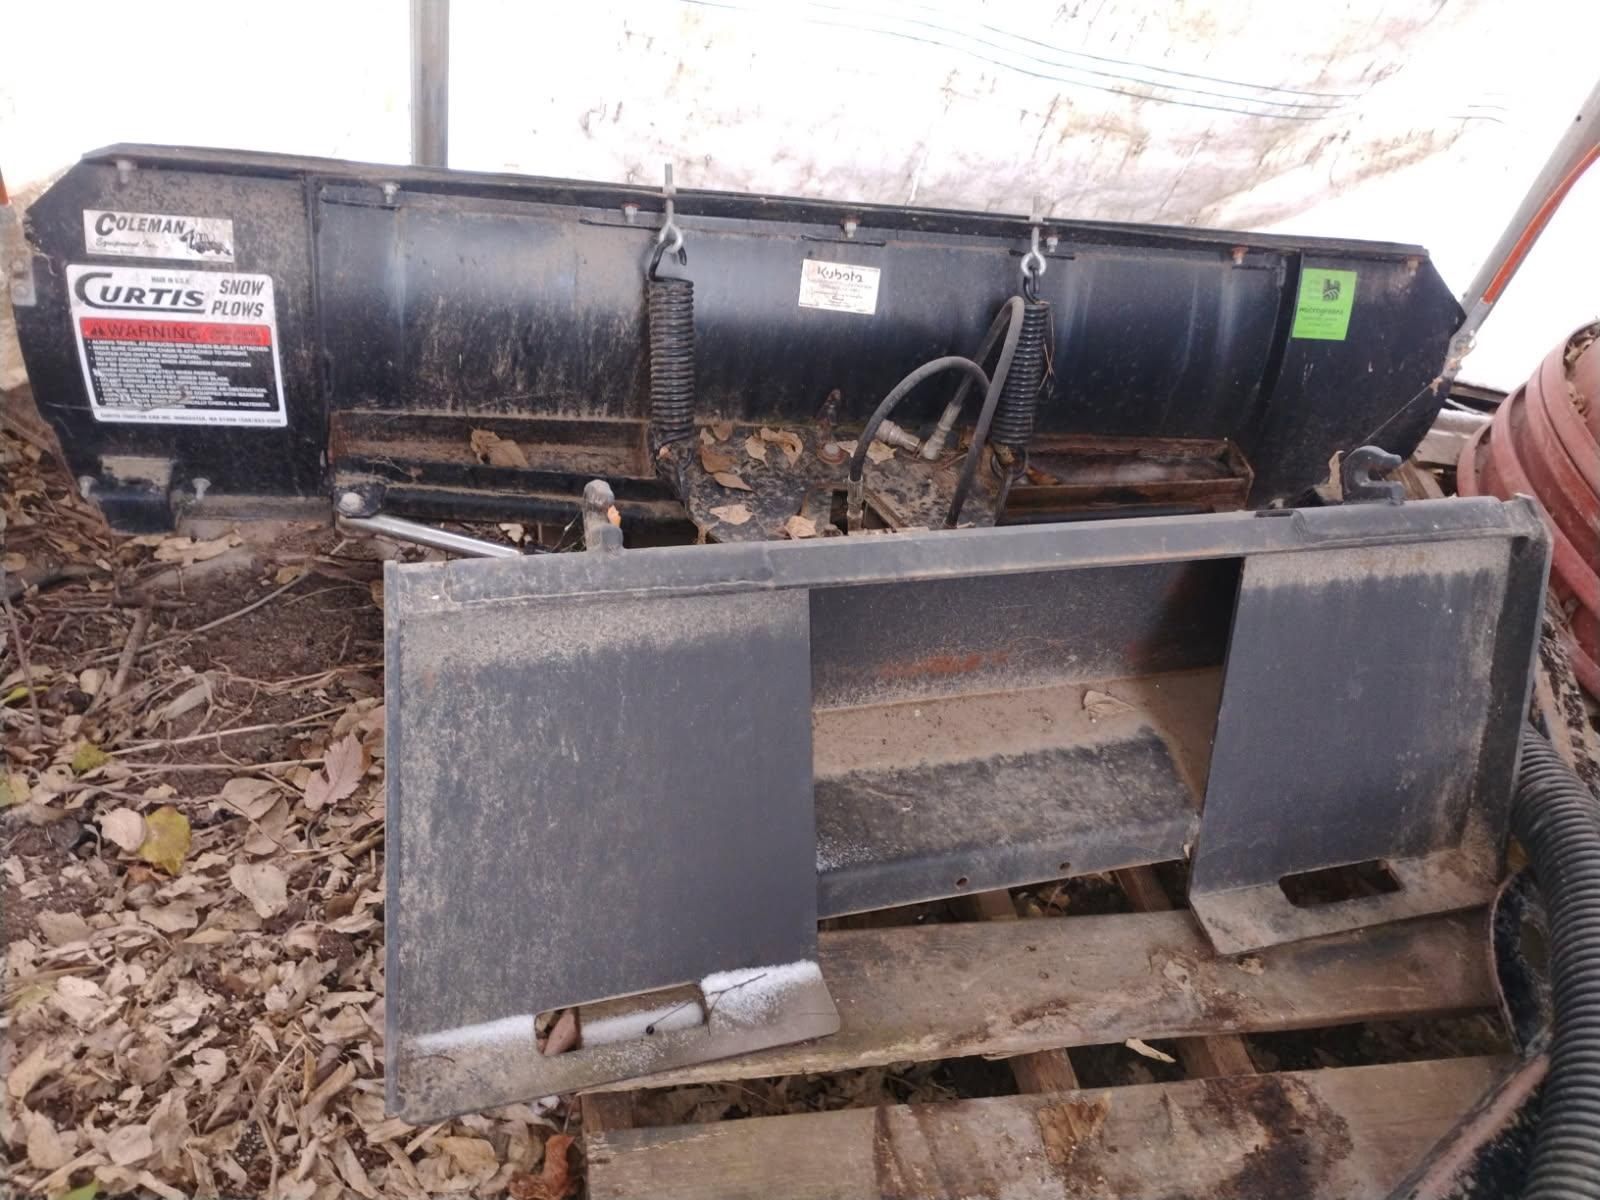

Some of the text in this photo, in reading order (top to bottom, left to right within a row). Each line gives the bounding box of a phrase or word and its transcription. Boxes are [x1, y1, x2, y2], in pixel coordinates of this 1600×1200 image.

[94, 212, 187, 236] COLEMAN
[817, 265, 864, 282] Kubota
[74, 272, 206, 314] CURTIS
[219, 279, 265, 295] SNOW
[211, 301, 264, 317] PLOWS
[107, 323, 200, 339] WARNING
